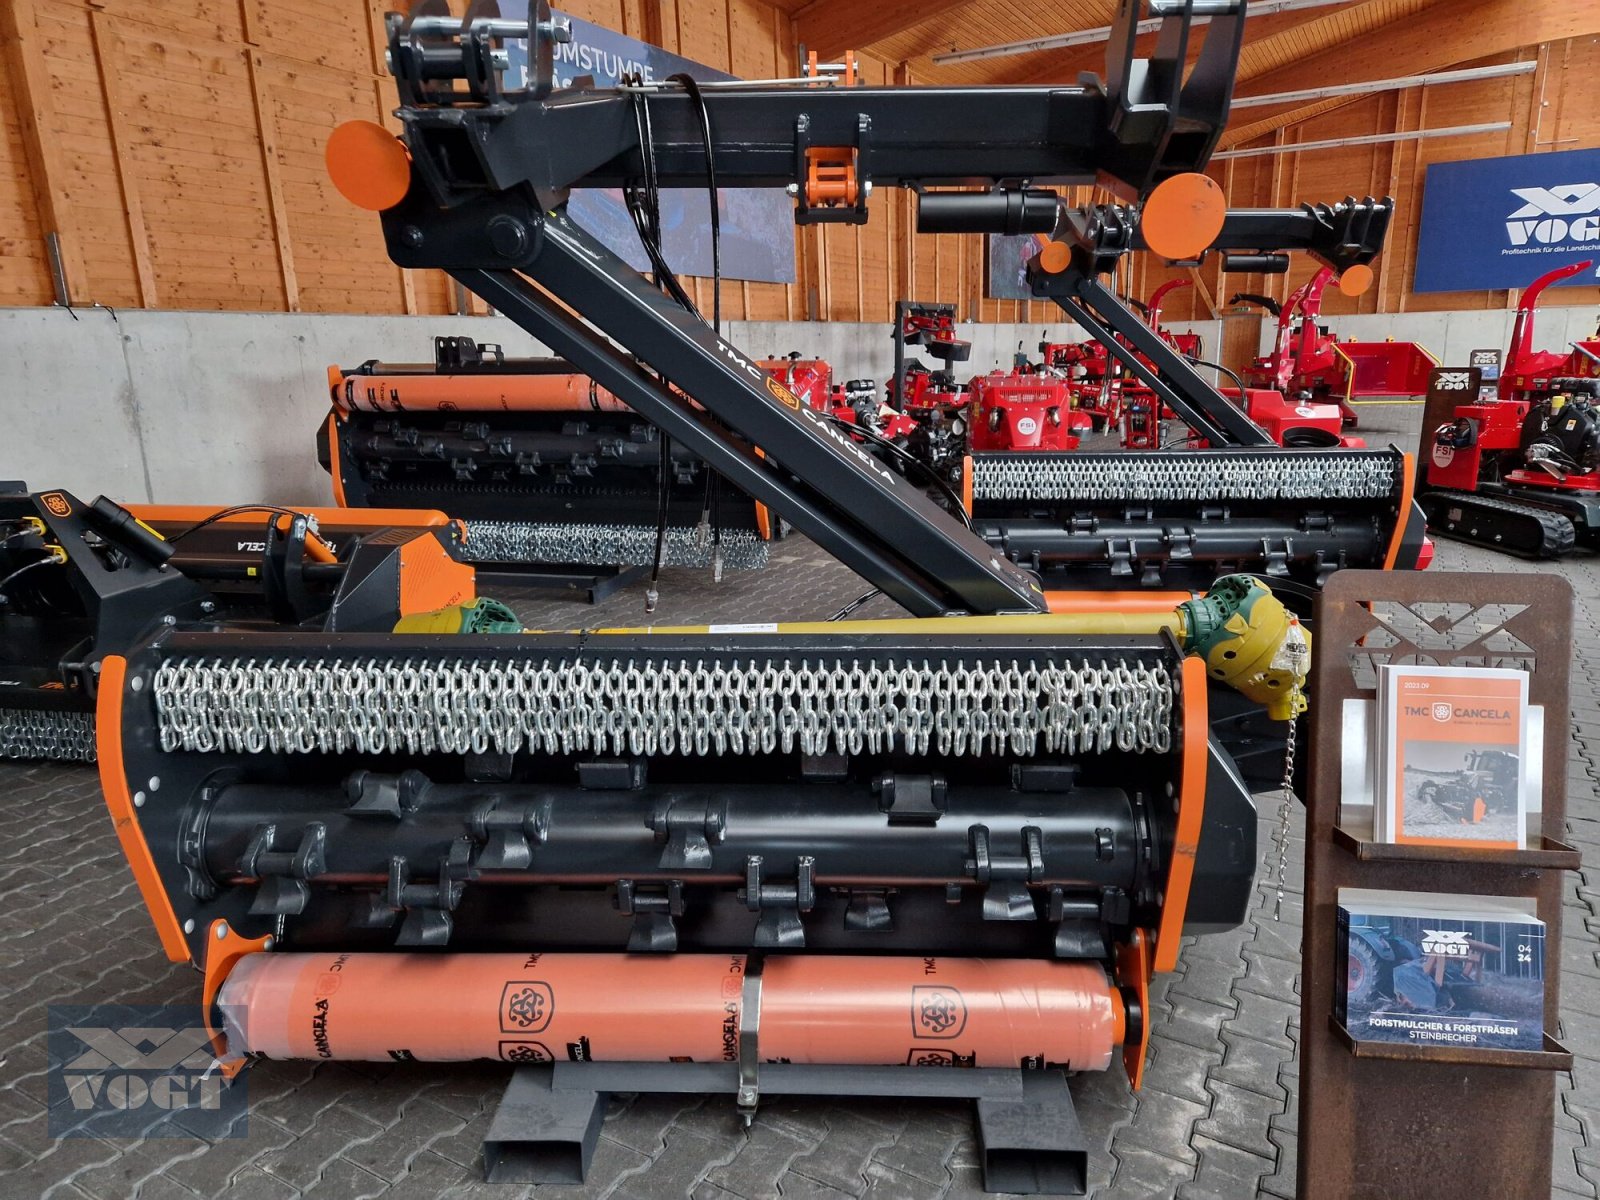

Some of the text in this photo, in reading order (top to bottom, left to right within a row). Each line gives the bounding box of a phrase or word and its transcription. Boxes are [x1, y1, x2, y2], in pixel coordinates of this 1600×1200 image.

[1505, 215, 1600, 246] VOG
[1501, 243, 1600, 256] Profitechnik für die Landscha
[716, 339, 895, 485] TMC CANCELA
[237, 541, 266, 551] CELA
[1404, 706, 1511, 720] TMC CANCELA
[1421, 942, 1470, 955] VOGT
[1517, 944, 1532, 953] 04
[1517, 953, 1532, 962] 24
[1369, 1018, 1518, 1036] FORSTMULCHER & FORSTFRÄSEN
[1409, 1031, 1477, 1043] STEINBRECHER
